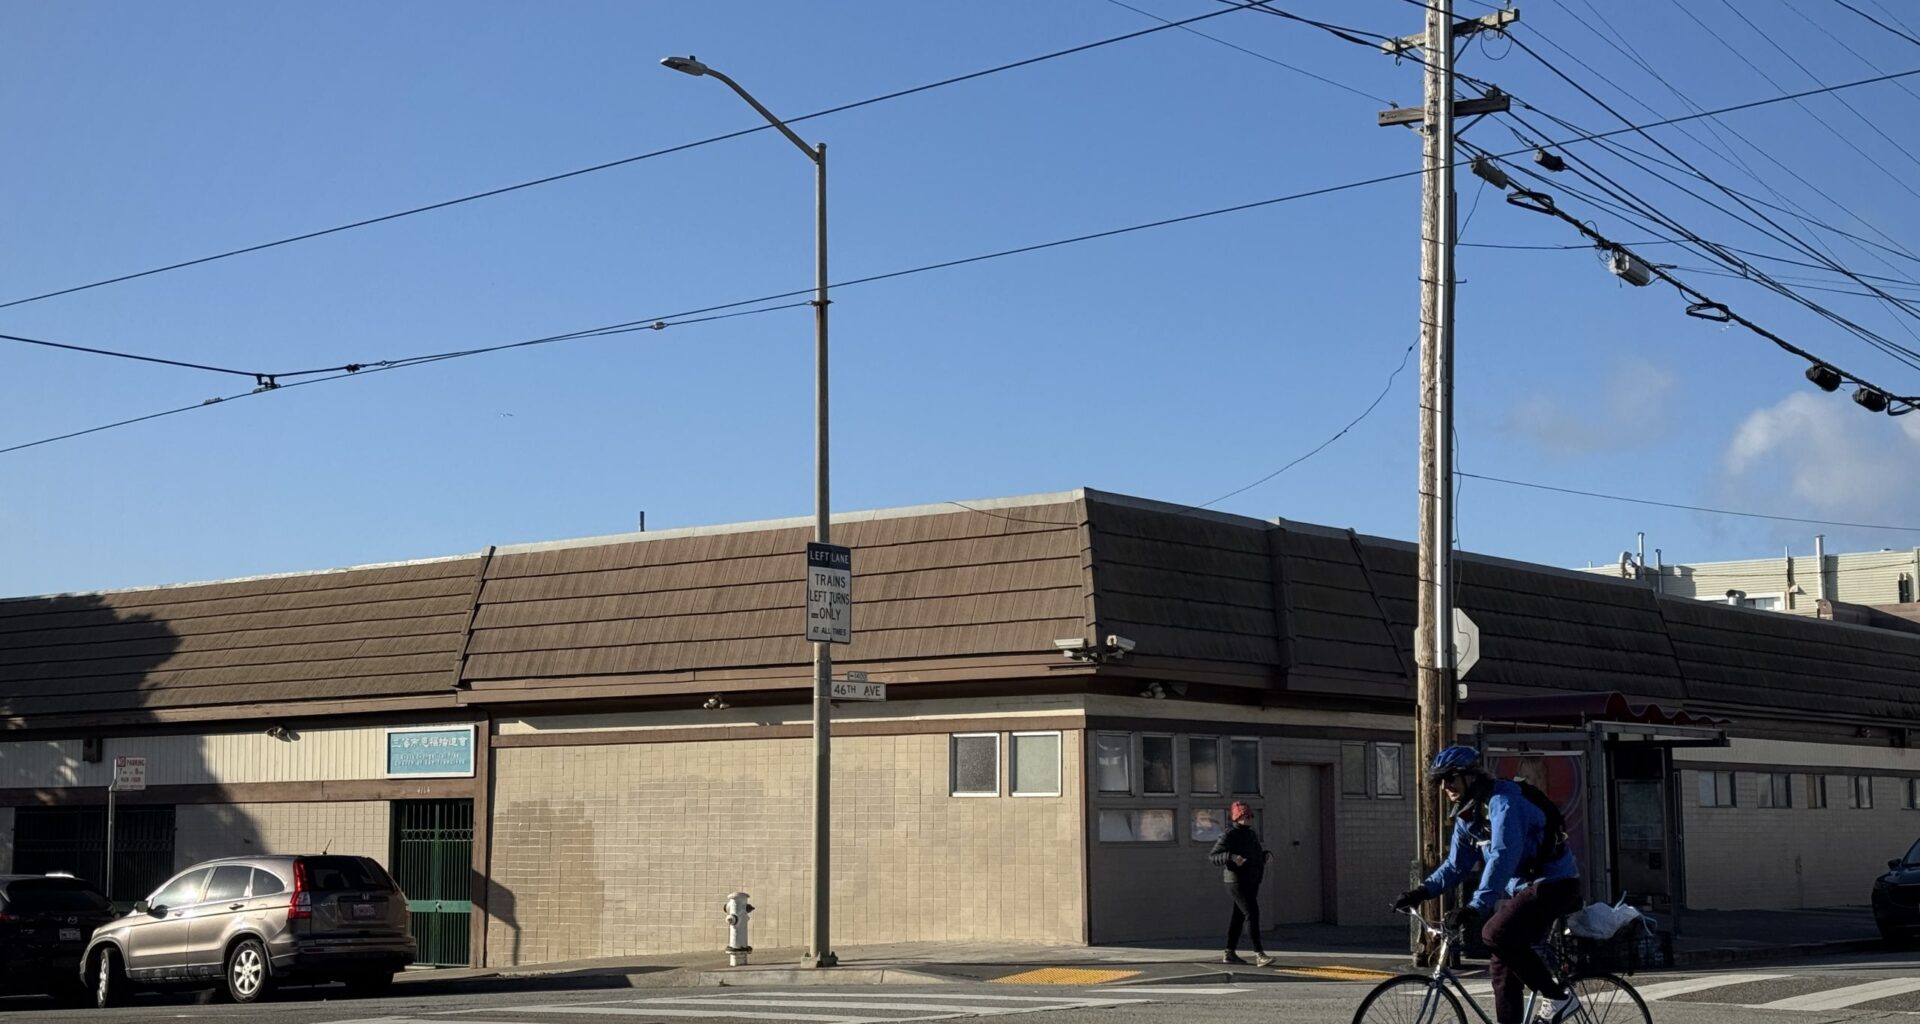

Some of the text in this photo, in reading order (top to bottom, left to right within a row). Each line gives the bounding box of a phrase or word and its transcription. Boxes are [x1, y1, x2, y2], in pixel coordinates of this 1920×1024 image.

[810, 550, 849, 564] LEFT LANE
[815, 573, 846, 588] TRAINS
[809, 589, 850, 606] LEFT TURNS
[819, 607, 842, 620] ONLY
[812, 626, 847, 637] AT ALL TIMES
[833, 684, 882, 697] 46TH AVE
[126, 759, 145, 767] PARKING
